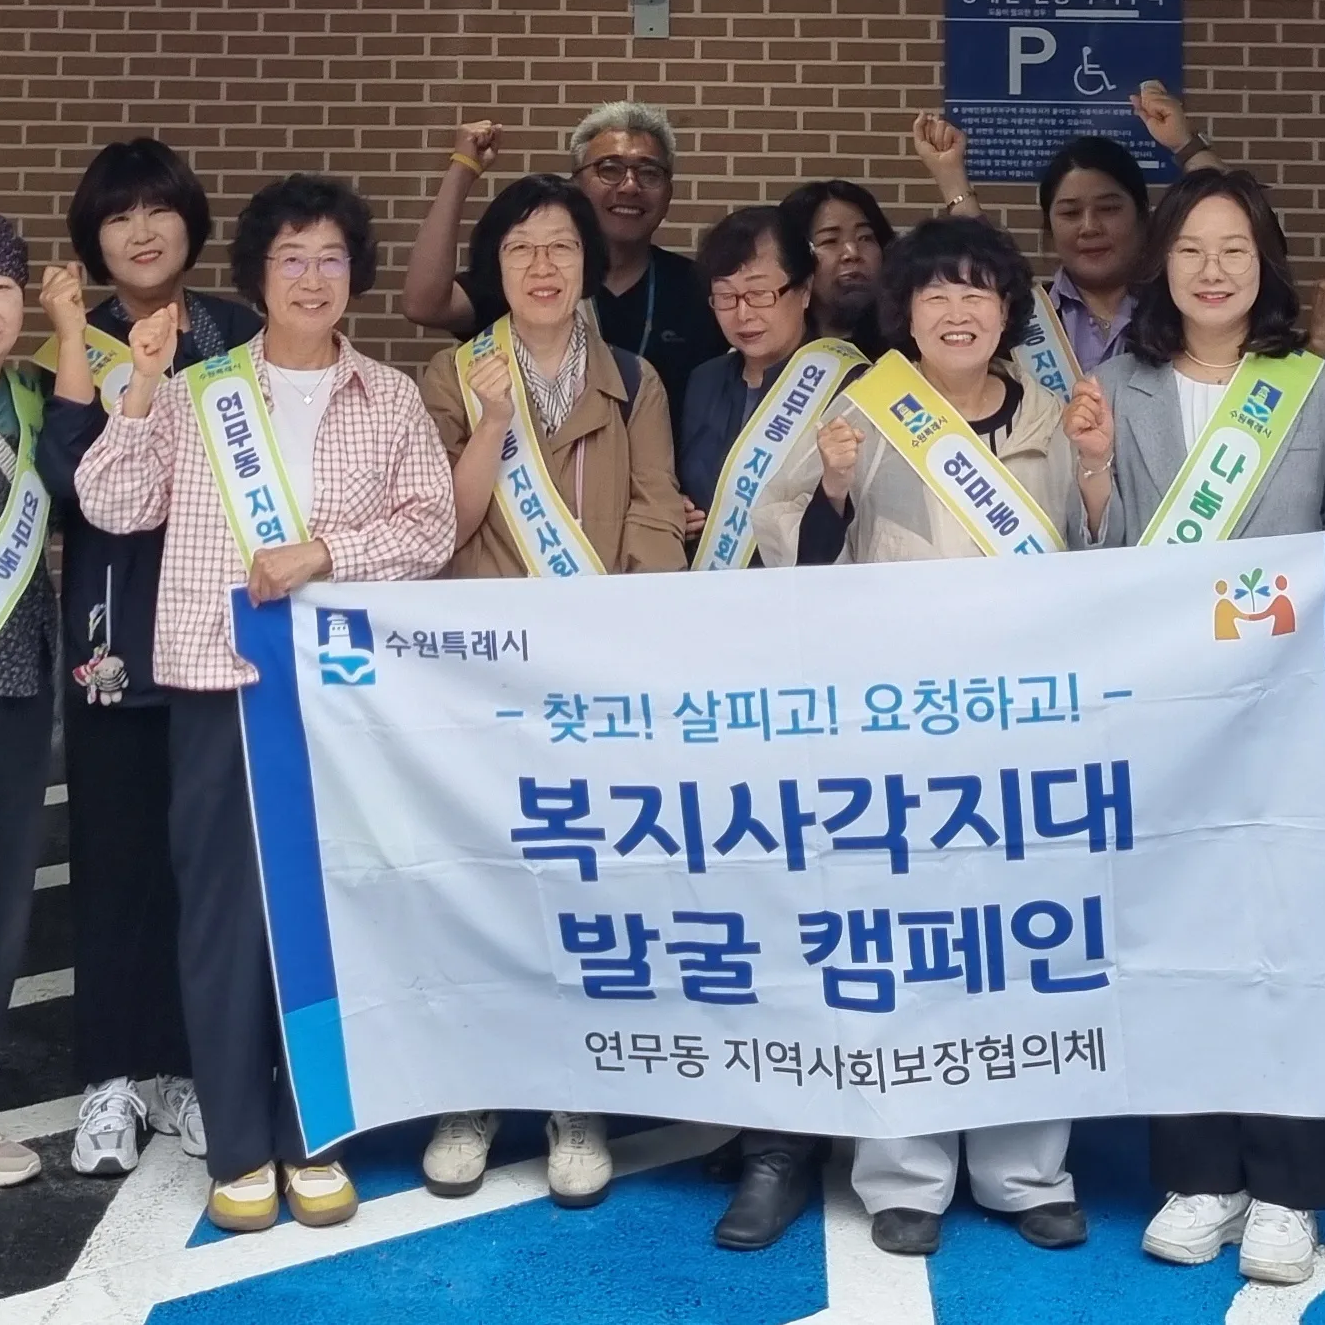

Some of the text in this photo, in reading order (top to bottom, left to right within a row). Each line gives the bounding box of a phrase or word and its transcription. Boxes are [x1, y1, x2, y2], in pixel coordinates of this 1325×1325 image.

[1009, 26, 1057, 96] P
[215, 390, 262, 480] 연무동
[764, 364, 827, 444] 연무동
[910, 414, 949, 449] 수원특례시
[942, 450, 1020, 538] 연무동
[1166, 442, 1247, 545] 나눔으
[384, 629, 530, 662] 수원특례시
[542, 691, 654, 744] 찾고!
[673, 685, 840, 744] 살피고!
[859, 671, 1082, 737] 요청하고!
[509, 759, 1135, 883] 복지사각지대
[557, 894, 1112, 1015] 발굴 캠페인
[583, 1026, 1109, 1095] 연무동 지역사회보장협의체
